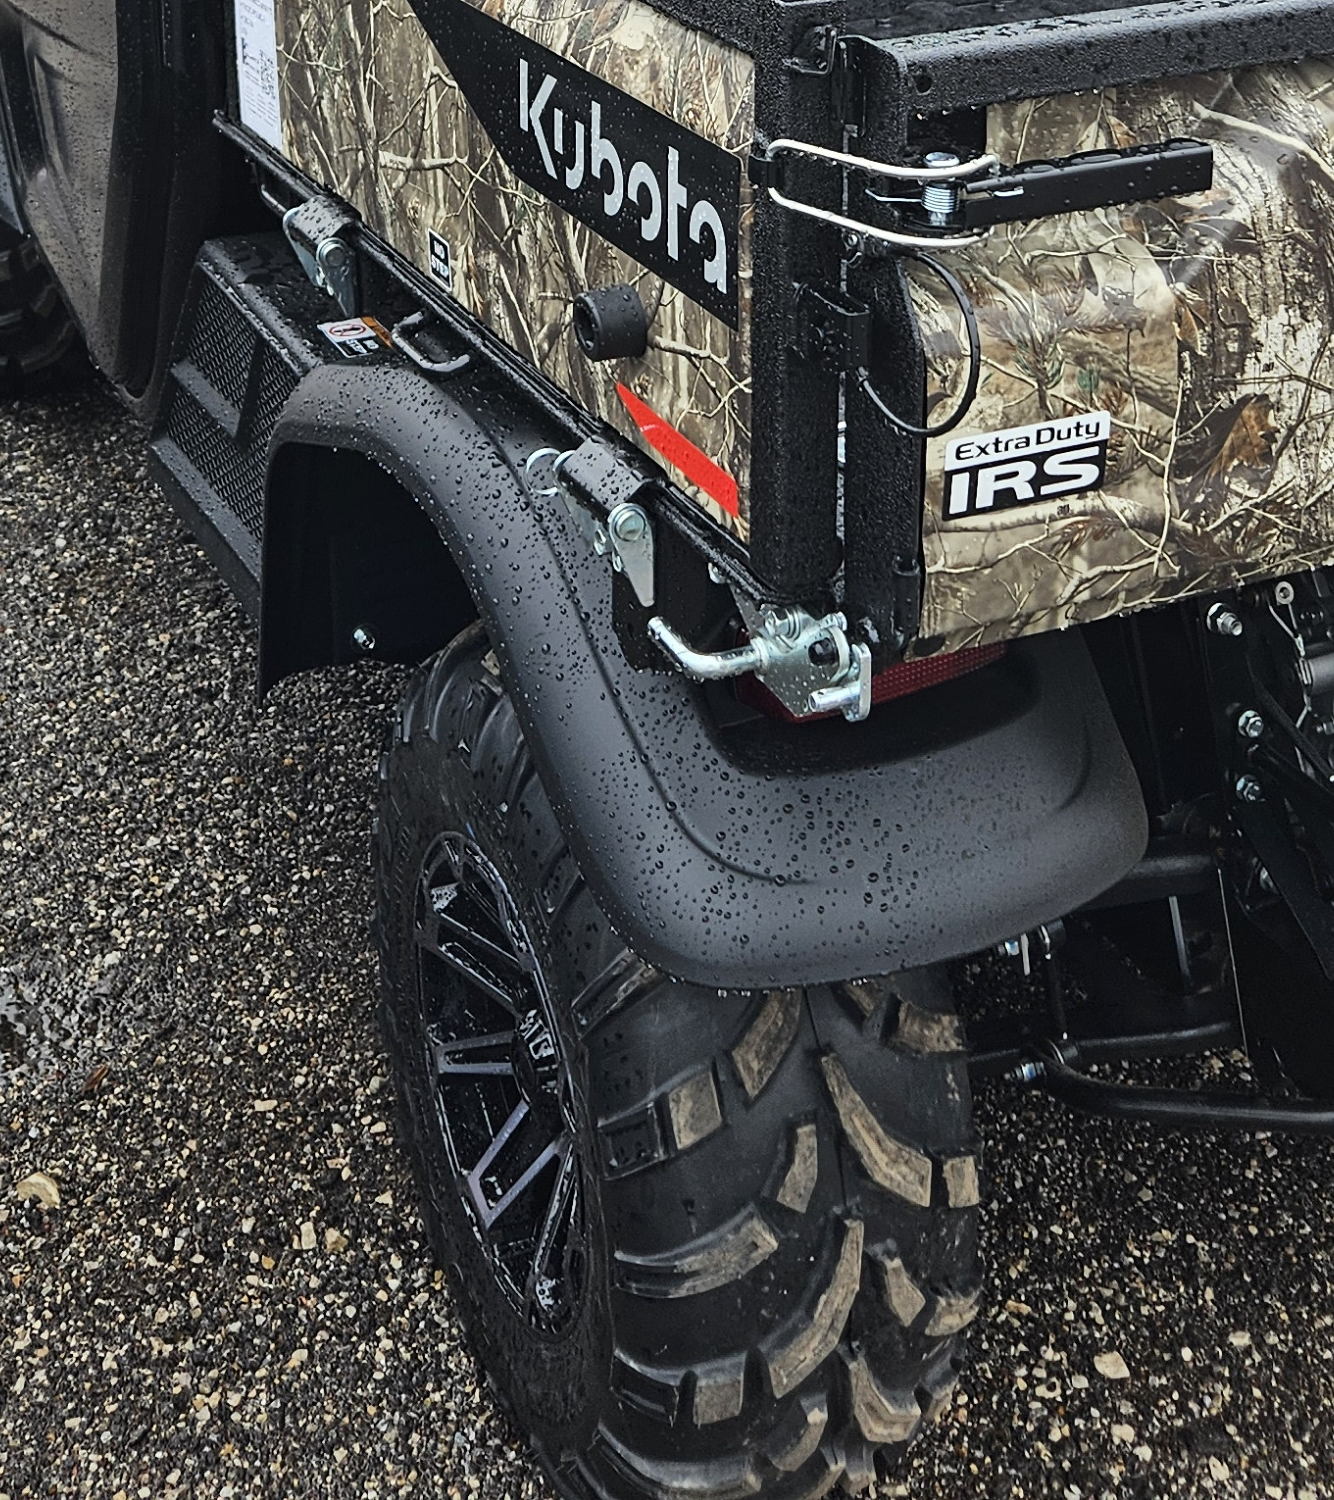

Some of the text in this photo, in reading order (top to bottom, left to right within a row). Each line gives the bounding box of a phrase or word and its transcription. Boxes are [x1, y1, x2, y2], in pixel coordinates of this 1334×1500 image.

[519, 58, 728, 295] Kubota
[433, 240, 446, 259] NO
[949, 445, 1100, 515] IRS
